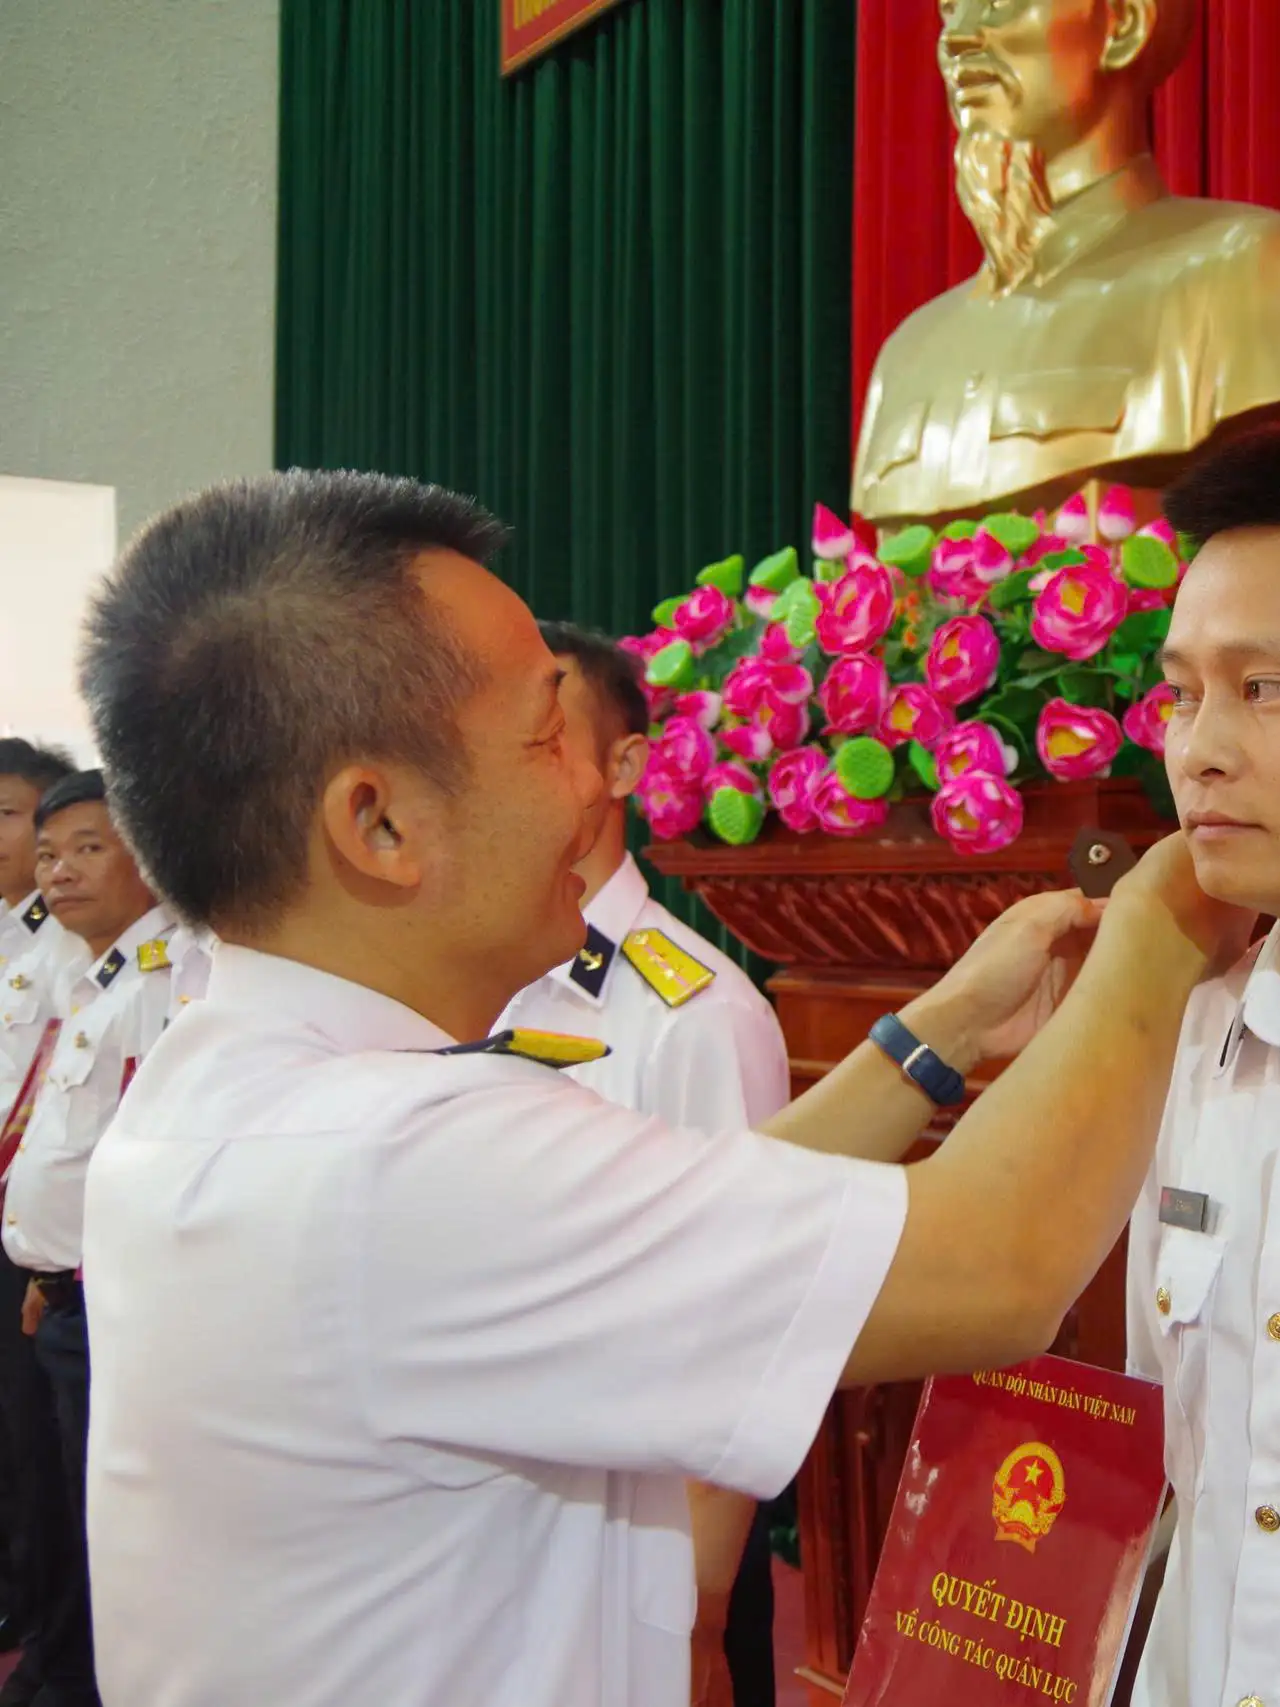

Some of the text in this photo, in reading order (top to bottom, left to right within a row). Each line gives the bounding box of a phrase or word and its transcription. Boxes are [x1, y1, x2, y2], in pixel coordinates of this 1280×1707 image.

[1109, 1403, 1136, 1425] NAM
[931, 1572, 1068, 1648] QUYẾT ĐỊNH
[896, 1608, 1078, 1704] VỀ CÔNG TÁC QUÂN LỰC
